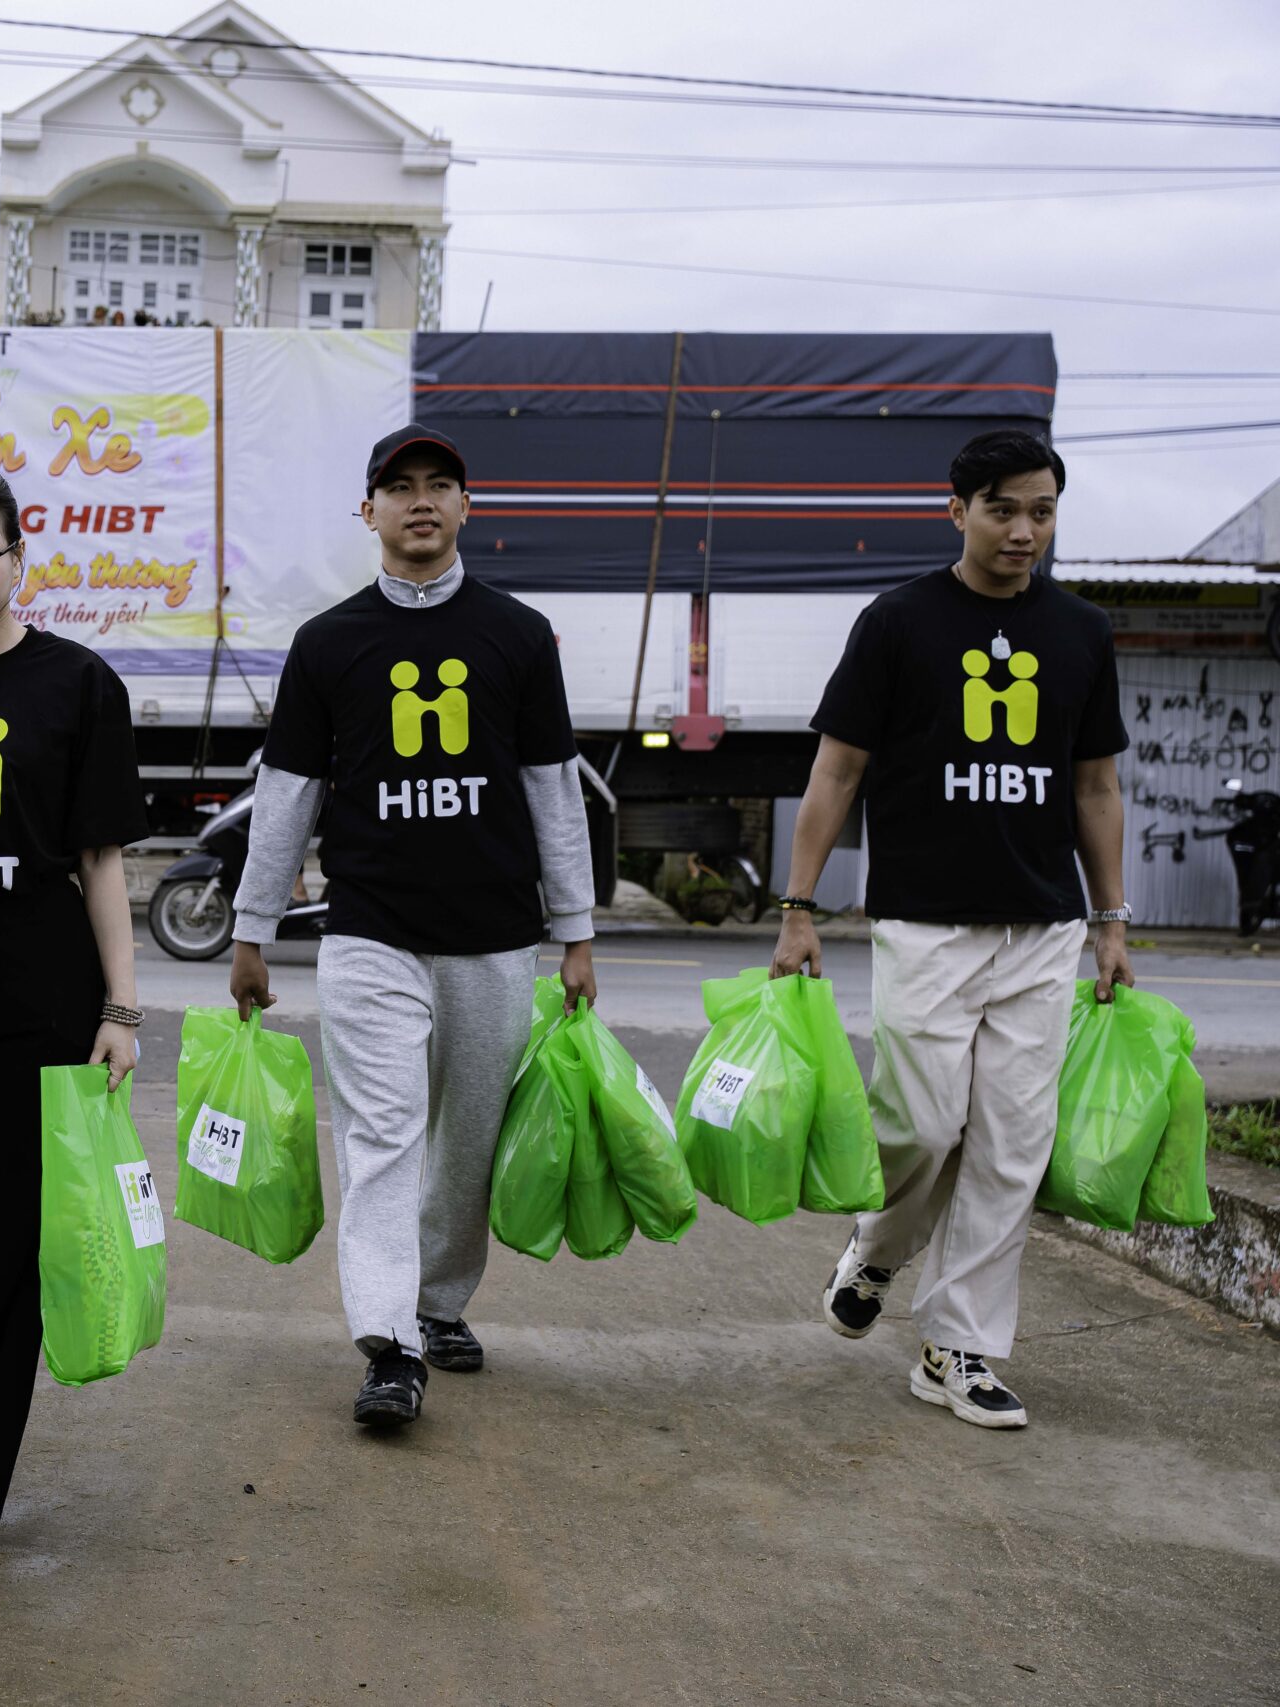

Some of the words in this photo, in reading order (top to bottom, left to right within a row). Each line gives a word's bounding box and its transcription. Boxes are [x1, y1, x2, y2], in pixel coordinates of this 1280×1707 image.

[48, 405, 142, 477] Xe
[60, 505, 165, 534] HIBT
[17, 551, 83, 608] yêu
[88, 551, 197, 609] thương
[54, 603, 98, 623] thân
[99, 602, 149, 634] yêu!
[378, 776, 488, 820] HiBT
[945, 762, 1053, 805] HiBT
